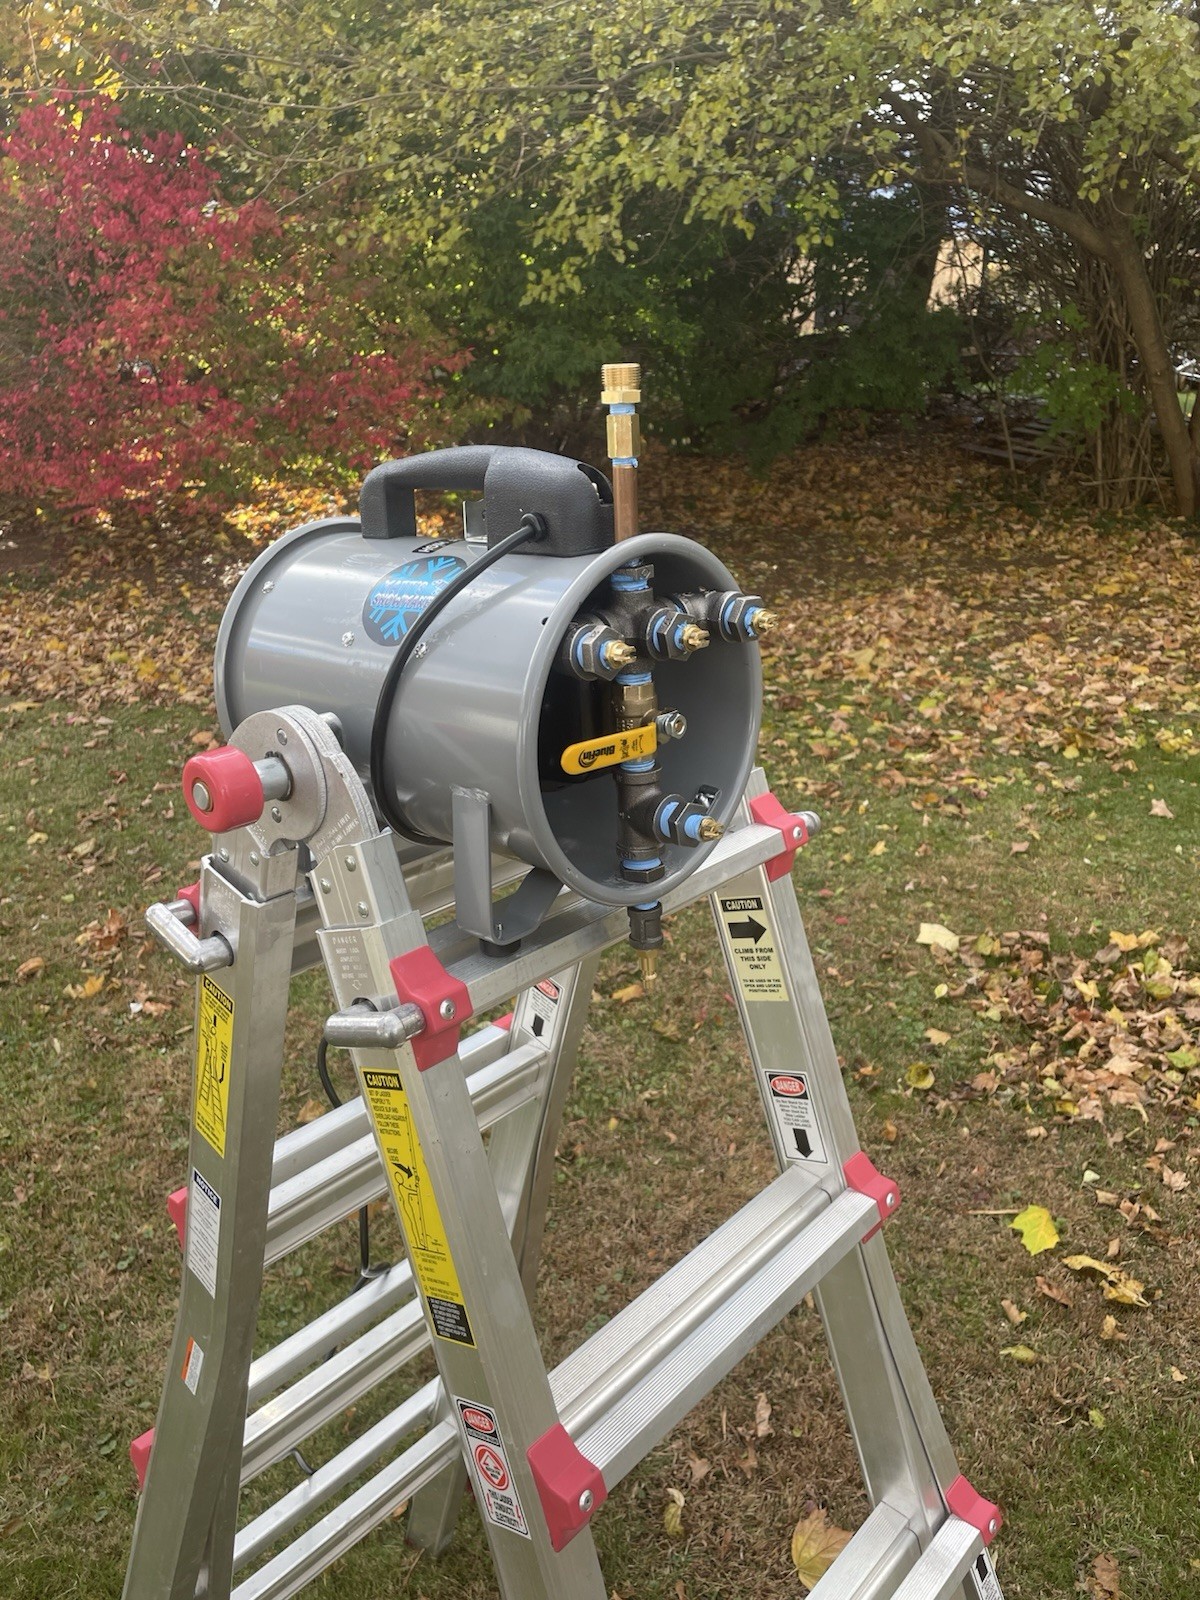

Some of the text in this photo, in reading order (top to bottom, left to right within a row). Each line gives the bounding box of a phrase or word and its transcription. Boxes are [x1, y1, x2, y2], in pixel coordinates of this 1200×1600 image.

[726, 899, 758, 910] CAUTION
[205, 980, 231, 1011] CAUTION
[366, 1074, 399, 1088] CAUTION
[775, 1080, 801, 1092] DANGER
[196, 1175, 218, 1206] NOTICE
[466, 1411, 491, 1430] DANGER
